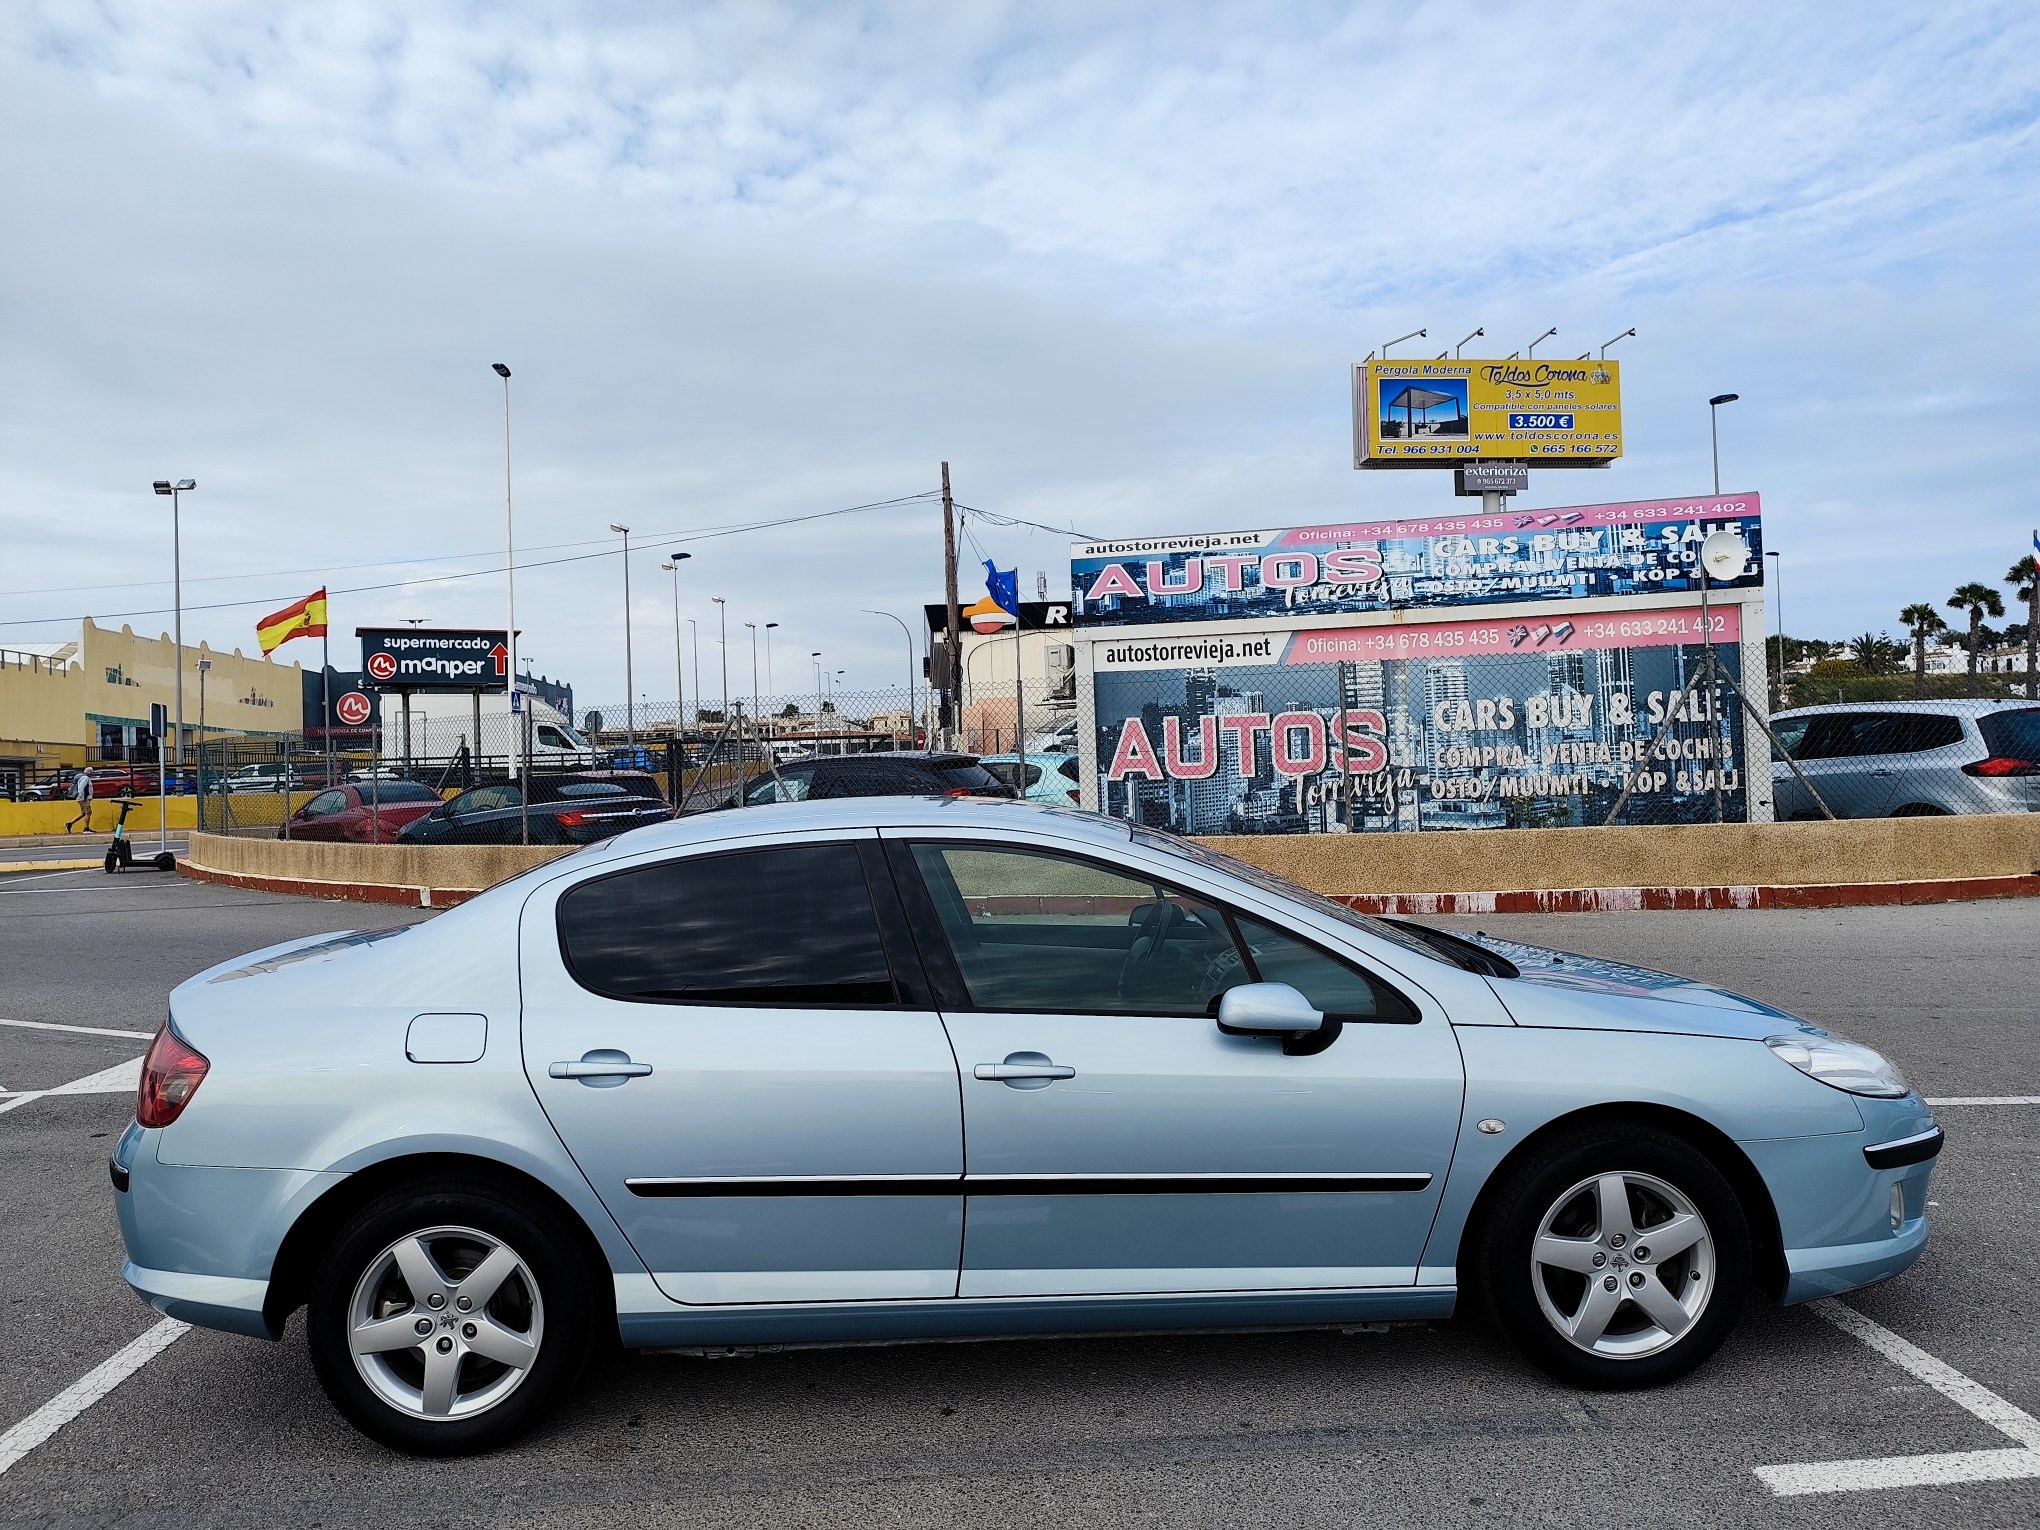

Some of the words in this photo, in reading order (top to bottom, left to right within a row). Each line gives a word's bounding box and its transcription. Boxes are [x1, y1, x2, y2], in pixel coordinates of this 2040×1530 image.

[1375, 365, 1418, 376] Pérgola
[1423, 365, 1472, 374] Moderna
[1480, 365, 1531, 386] Toldos
[1535, 365, 1587, 382] Corona
[1505, 390, 1521, 400] 3,5
[1525, 391, 1531, 399] x
[1534, 390, 1551, 400] 5,0
[1554, 390, 1577, 399] mts.
[1473, 403, 1525, 412] Compatible
[1547, 403, 1582, 412] paneles
[1515, 416, 1555, 428] 3.500
[1558, 416, 1570, 427] €
[1474, 431, 1618, 440] www.toldoscorona.es
[1376, 445, 1399, 454] Tel.
[1403, 445, 1426, 454] 966
[1430, 445, 1452, 454] 931
[1456, 445, 1480, 454] 004
[1542, 444, 1565, 453] 665
[1569, 444, 1592, 453] 166
[1595, 444, 1618, 453] 572
[1465, 466, 1527, 476] exterioriza
[1595, 510, 1628, 520] +34
[1633, 508, 1667, 518] 633
[1673, 505, 1706, 516] 241
[1711, 502, 1746, 513] 402
[1299, 529, 1356, 540] Oficina:
[1361, 526, 1392, 536] +34
[1397, 523, 1429, 533] 678
[1434, 521, 1466, 531] 435
[1471, 518, 1504, 529] 435
[1085, 533, 1261, 554] autostorrevieja.net
[1434, 535, 1519, 557] CARS
[1533, 530, 1605, 553] BUY
[1622, 528, 1647, 547] &
[1551, 555, 1621, 570] VENTA
[1630, 552, 1658, 565] DE
[1085, 548, 1384, 601] AUTOS
[1633, 566, 1680, 582] KÖP
[1278, 576, 1414, 608] Torrevieja
[1584, 622, 1615, 638] +34
[1621, 620, 1653, 636] 633
[1657, 618, 1688, 634] 241
[1693, 616, 1725, 632] 402
[383, 637, 491, 651] supermercado
[1106, 637, 1271, 663] autostorrevieja.net
[1307, 638, 1361, 653] Oficina:
[1365, 635, 1395, 650] +34
[1400, 633, 1430, 649] 678
[1434, 631, 1464, 646] 435
[1469, 629, 1500, 644] 435
[400, 656, 486, 679] manper
[1434, 697, 1515, 732] CARS
[1528, 694, 1594, 729] BUY
[1609, 692, 1635, 725] &
[1107, 708, 1390, 781] AUTOS
[1546, 741, 1612, 765] VENTA
[1620, 741, 1646, 762] DE
